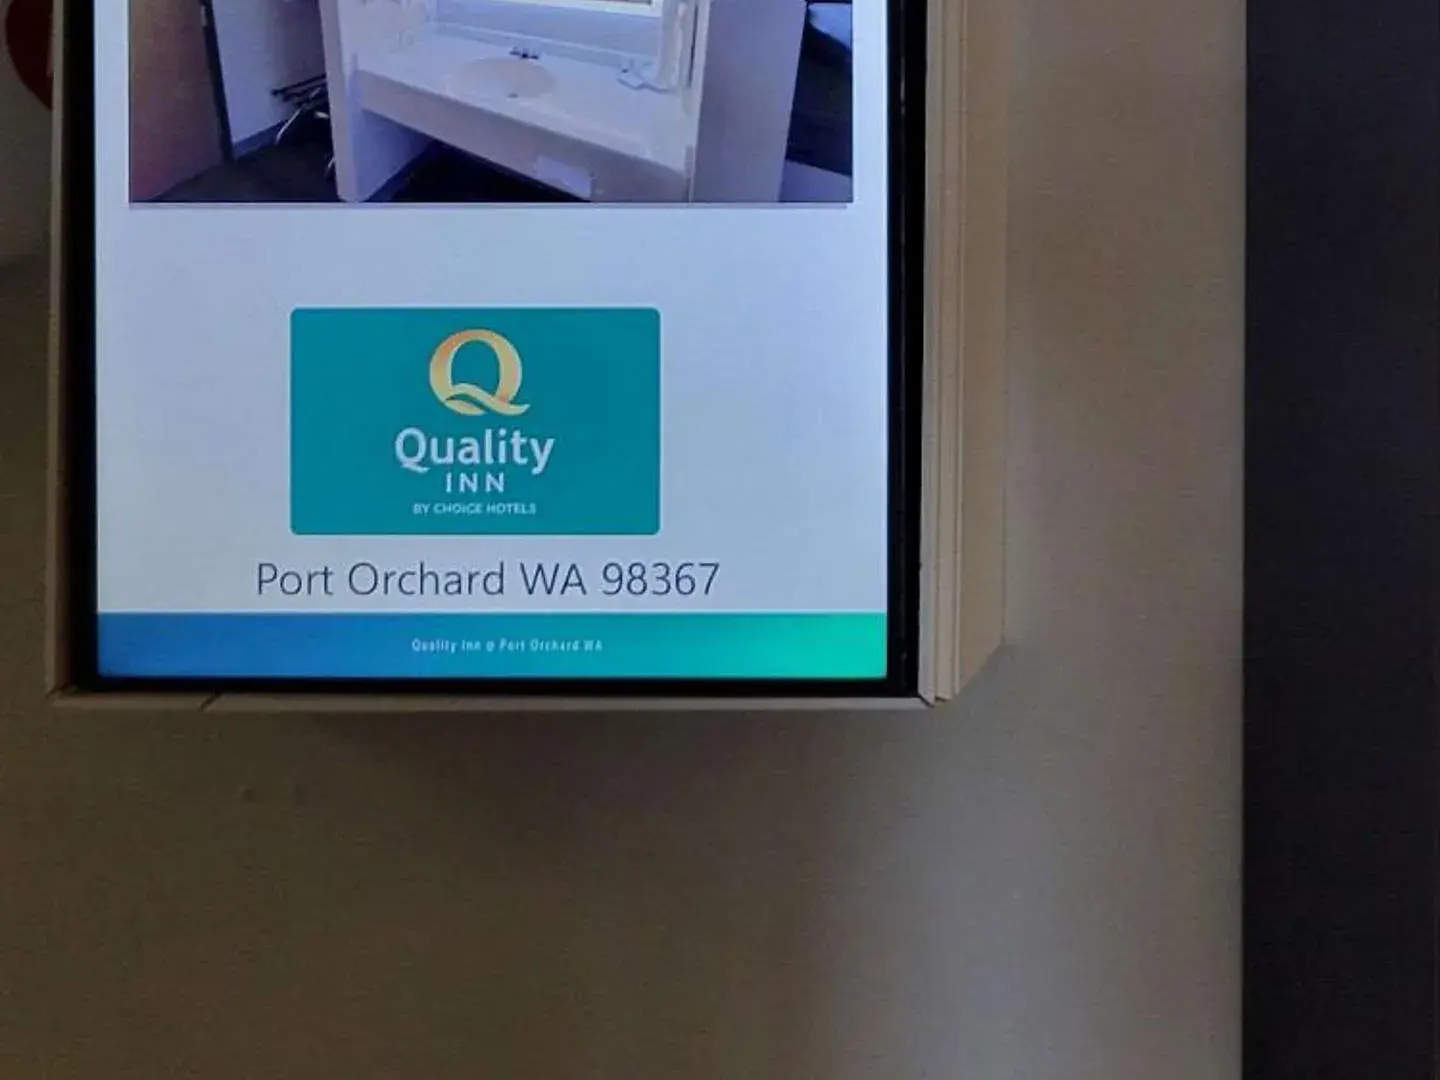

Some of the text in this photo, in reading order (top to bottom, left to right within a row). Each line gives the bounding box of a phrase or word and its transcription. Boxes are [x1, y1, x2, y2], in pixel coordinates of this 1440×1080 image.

[395, 427, 555, 474] Quality
[445, 472, 506, 493] INN
[412, 502, 537, 515] BY CHOICE HOTELS
[257, 561, 721, 596] Port Orchard WA 98367
[411, 638, 457, 655] Quality
[461, 639, 481, 652] Inn
[499, 639, 526, 652] Port
[529, 638, 579, 652] Orchard
[583, 639, 603, 652] WA
